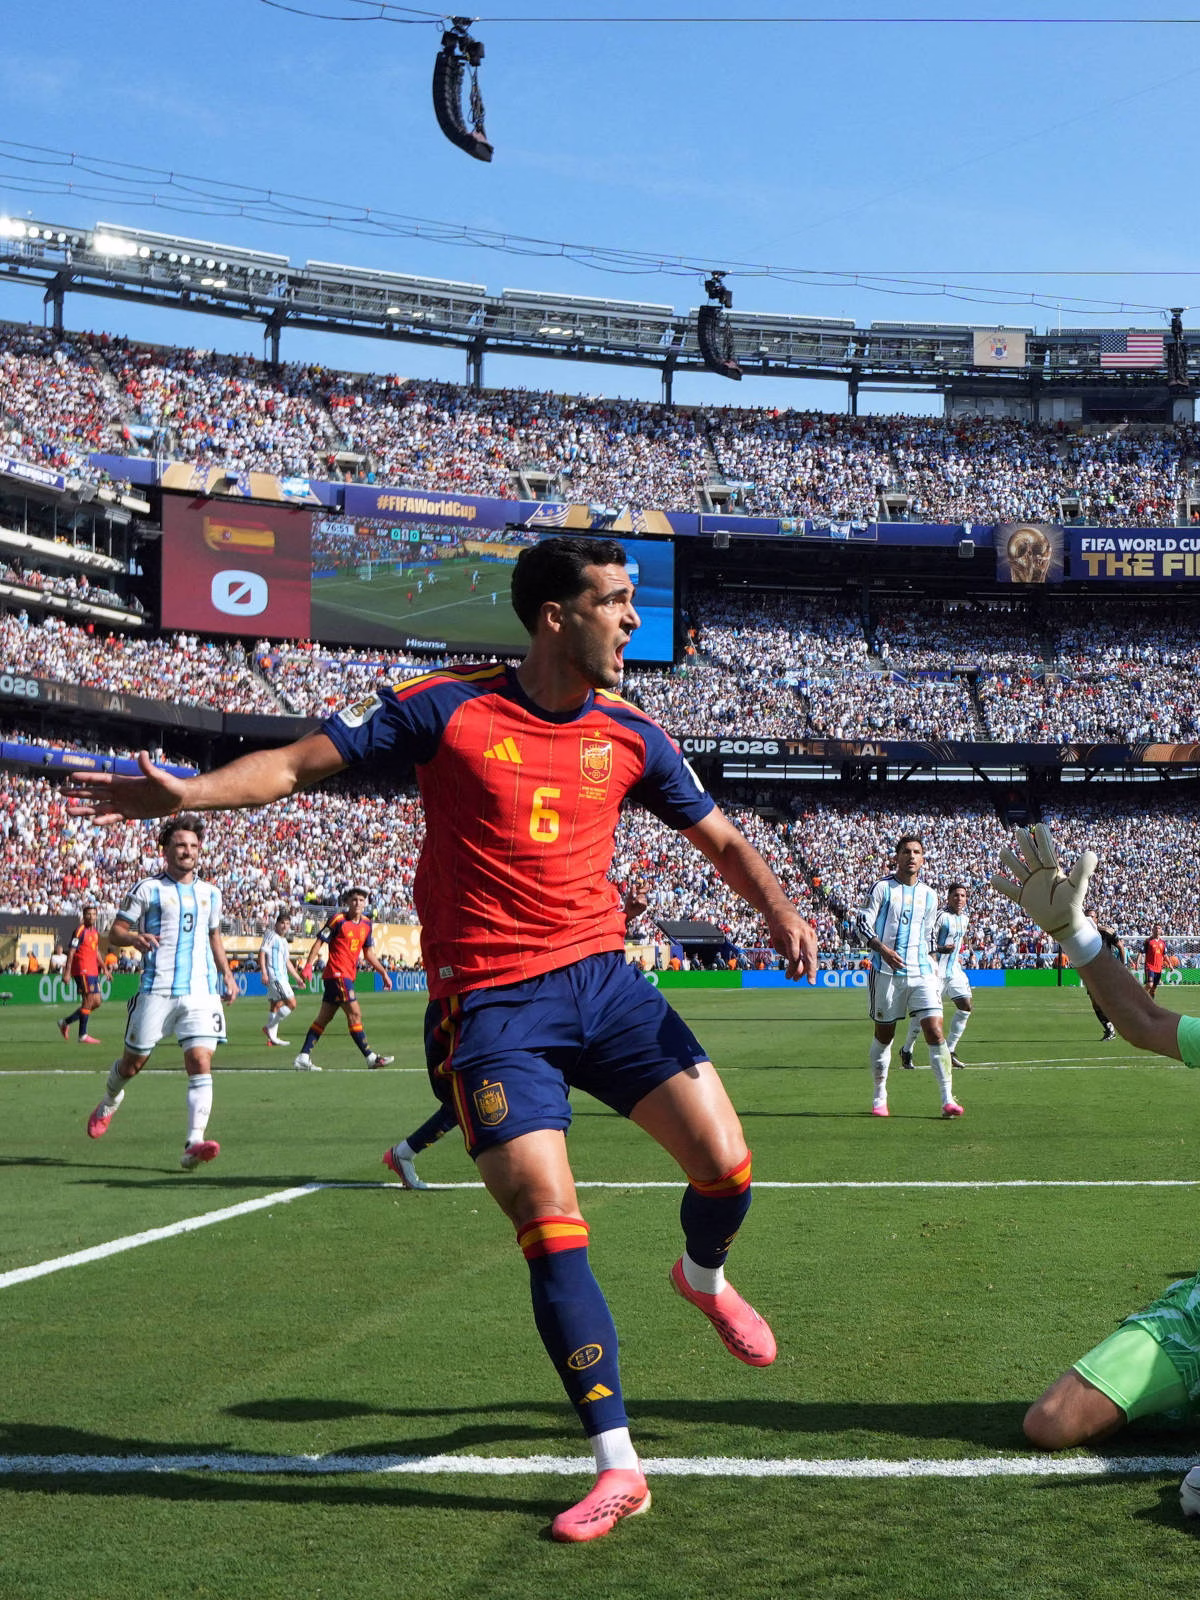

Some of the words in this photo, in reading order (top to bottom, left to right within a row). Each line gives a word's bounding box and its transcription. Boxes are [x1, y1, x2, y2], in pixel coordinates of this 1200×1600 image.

[377, 495, 477, 520] #FIFAWorldCup
[326, 522, 350, 533] 76:51
[1081, 538, 1116, 551] FIFA
[1117, 538, 1177, 551] WORLD
[1081, 553, 1154, 577] THE
[406, 638, 447, 650] Hisense
[683, 738, 717, 753] CUP
[719, 739, 779, 755] 2026
[785, 742, 825, 756] THE
[828, 742, 887, 757] INAL
[529, 787, 560, 843] 6
[183, 912, 193, 932] 3
[902, 910, 910, 925] 5
[396, 973, 428, 990] aramc
[823, 970, 868, 987] ara
[39, 975, 112, 1003] arao
[212, 1013, 222, 1032] 3
